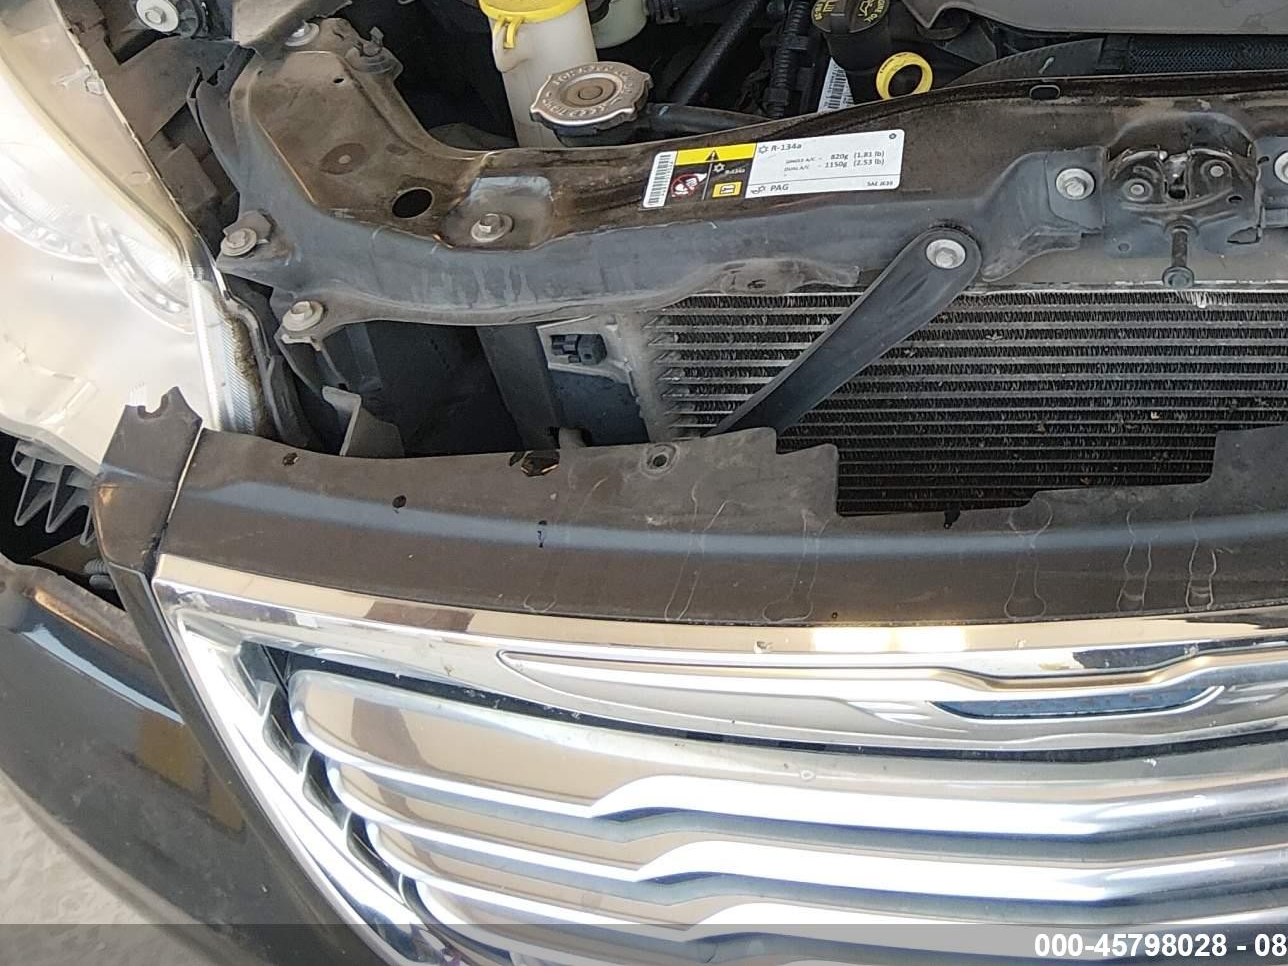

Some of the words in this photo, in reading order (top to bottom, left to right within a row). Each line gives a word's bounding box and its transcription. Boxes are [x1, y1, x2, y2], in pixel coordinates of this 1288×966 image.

[864, 13, 878, 23] OIL
[770, 143, 802, 152] R-134a
[830, 153, 849, 162] 820g
[853, 151, 872, 159] (1.81
[874, 150, 885, 158] lb)
[824, 160, 848, 169] 1150g
[853, 158, 872, 167] (2.53
[874, 158, 885, 166] lb)
[770, 183, 789, 192] PAG
